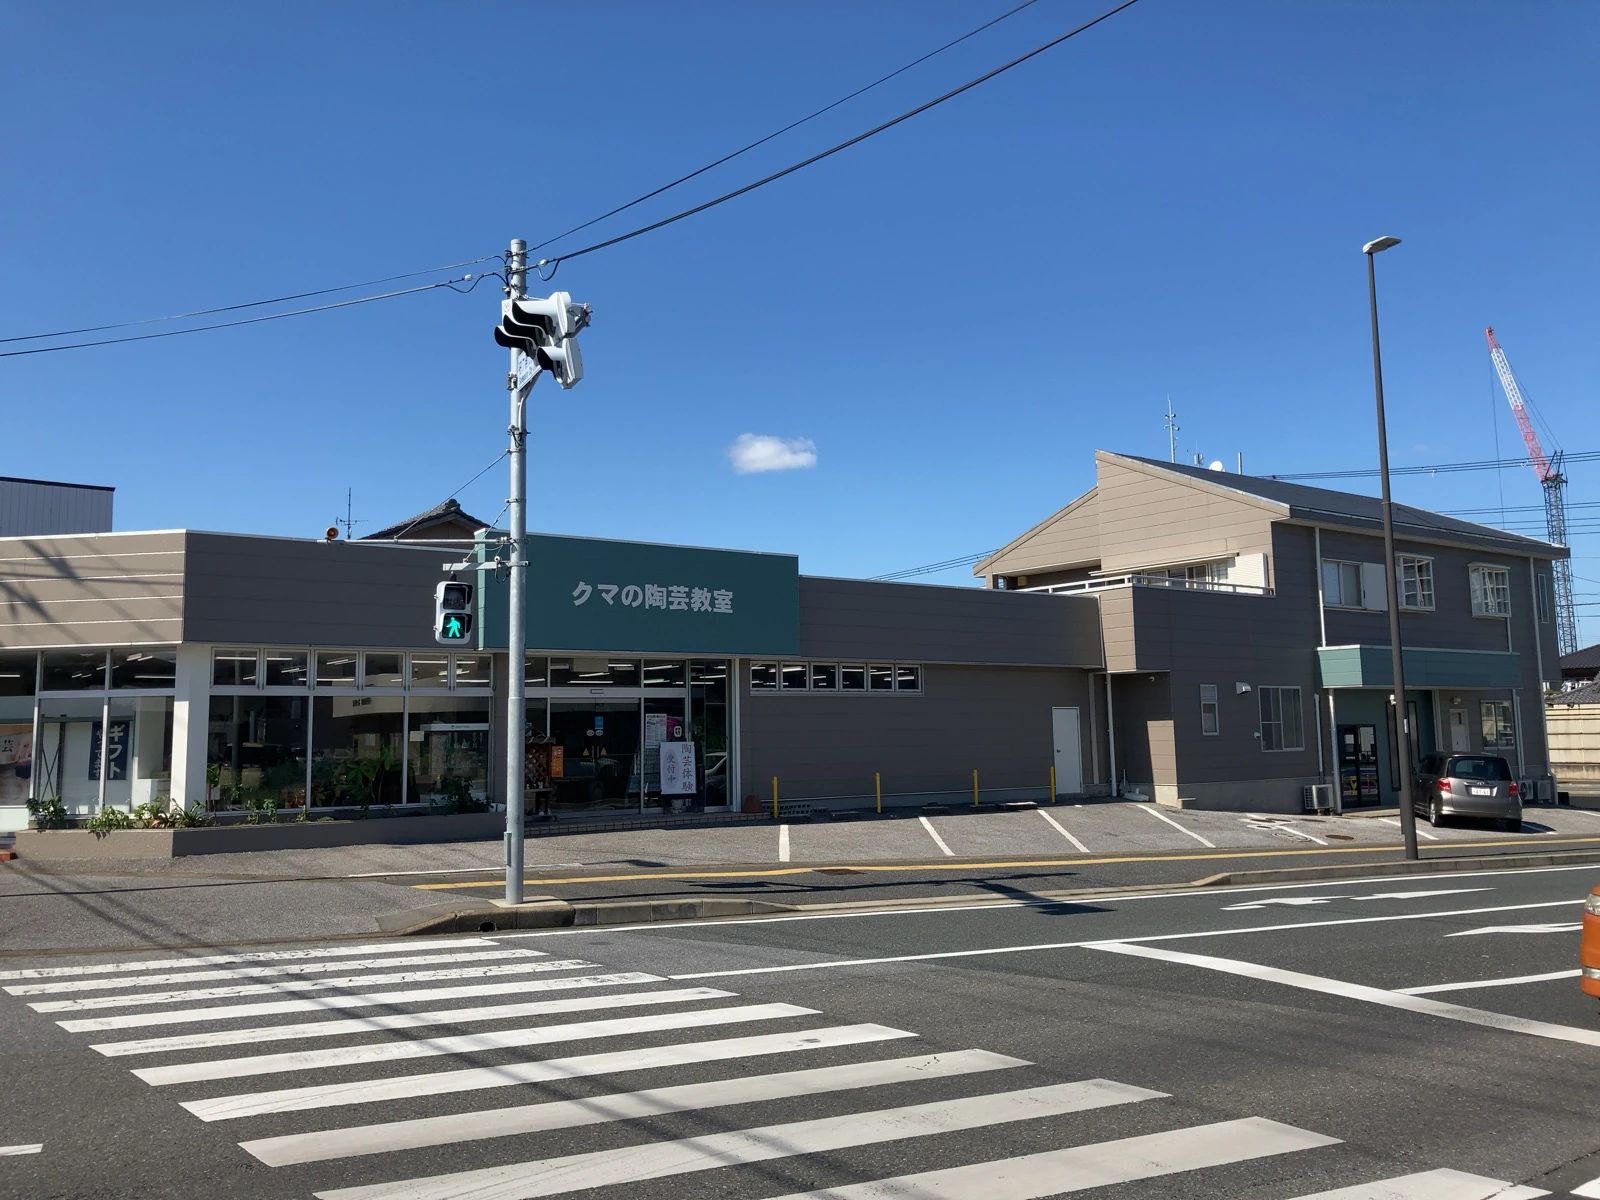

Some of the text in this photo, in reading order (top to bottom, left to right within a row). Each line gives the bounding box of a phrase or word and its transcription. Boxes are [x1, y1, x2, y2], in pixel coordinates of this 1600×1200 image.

[573, 582, 733, 613] クマの陶芸教室
[108, 724, 125, 779] ギフト
[666, 752, 676, 784] 受付中
[681, 743, 694, 792] 陶芸体験
